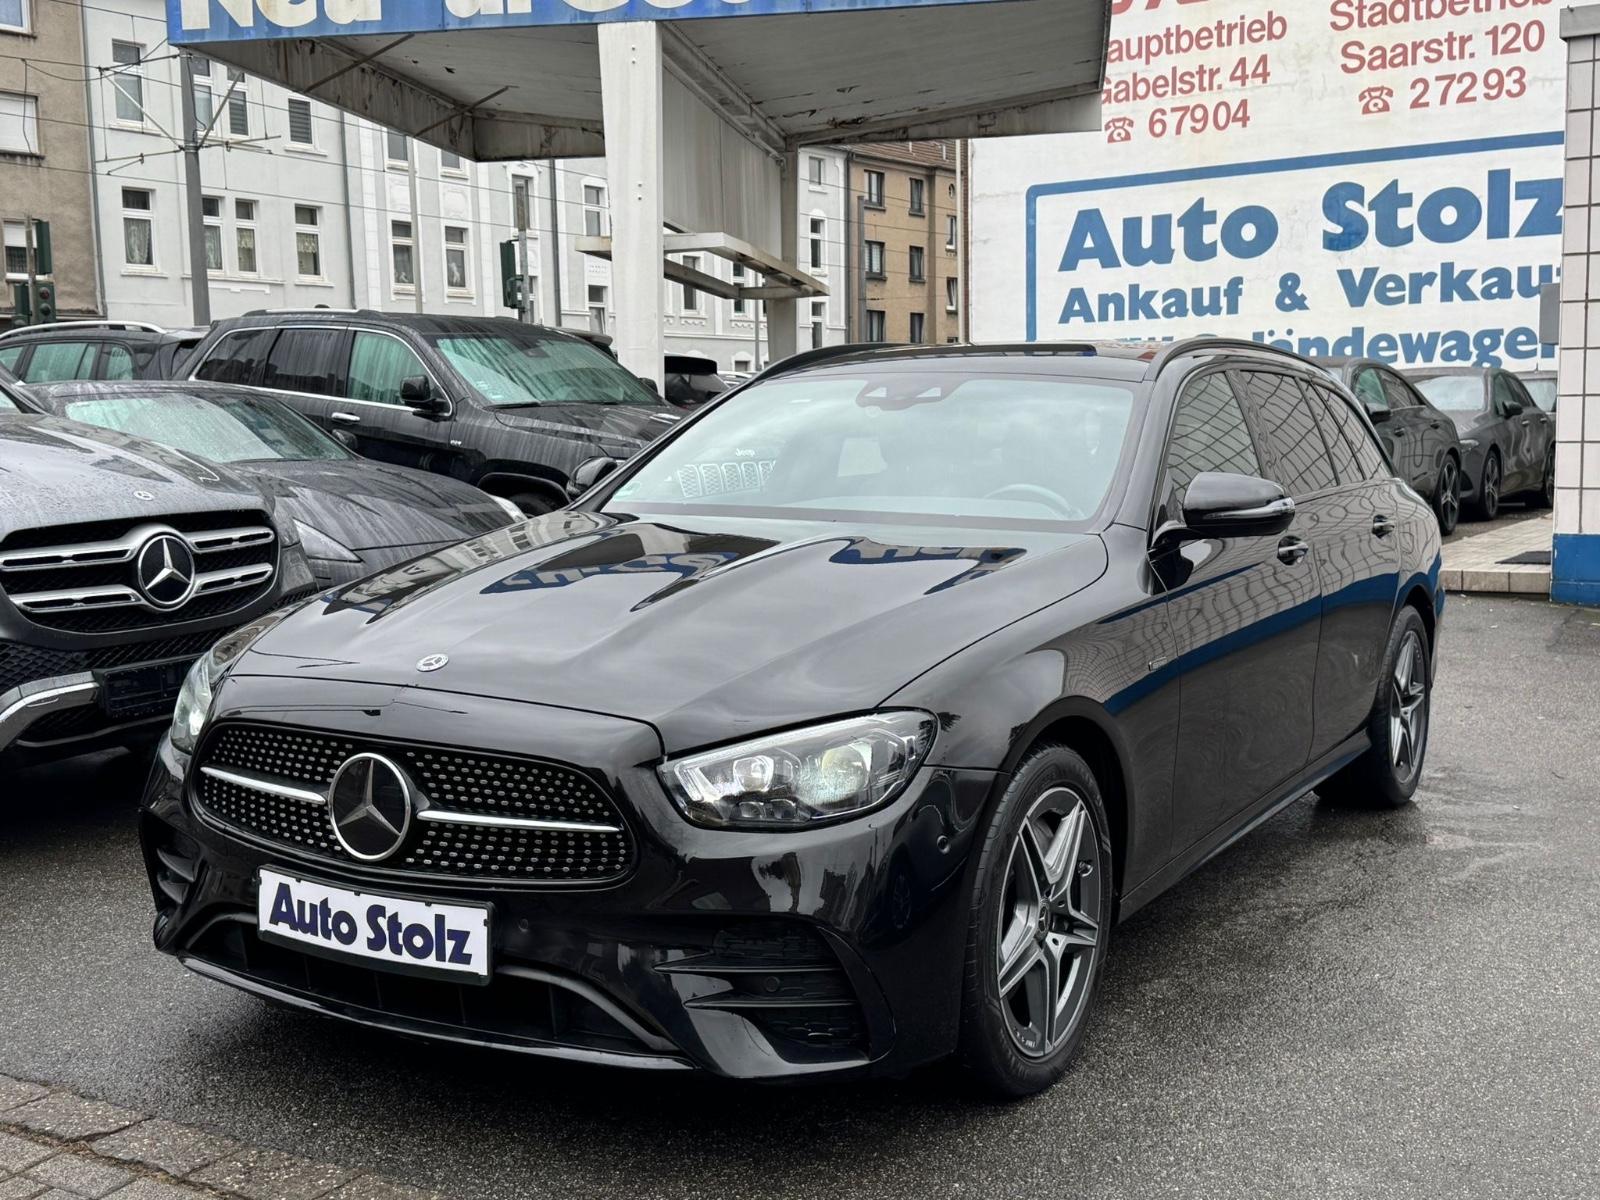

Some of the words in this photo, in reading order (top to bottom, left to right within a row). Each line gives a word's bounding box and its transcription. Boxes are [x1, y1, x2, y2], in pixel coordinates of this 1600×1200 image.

[1107, 10, 1287, 65] auptbetrieb
[1330, 0, 1551, 31] Stadtbe
[1229, 54, 1271, 87] 44
[1340, 31, 1475, 74] Saarstr.
[1484, 20, 1545, 56] 120
[1409, 66, 1527, 109] 27293
[1149, 98, 1250, 138] 67904
[1057, 196, 1279, 272] Auto
[1322, 168, 1563, 252] Stolz
[1057, 276, 1244, 325] Ankauf
[1274, 272, 1310, 312] &
[1336, 261, 1561, 308] Verkau
[268, 881, 358, 946] Auto
[365, 903, 473, 965] Stolz
